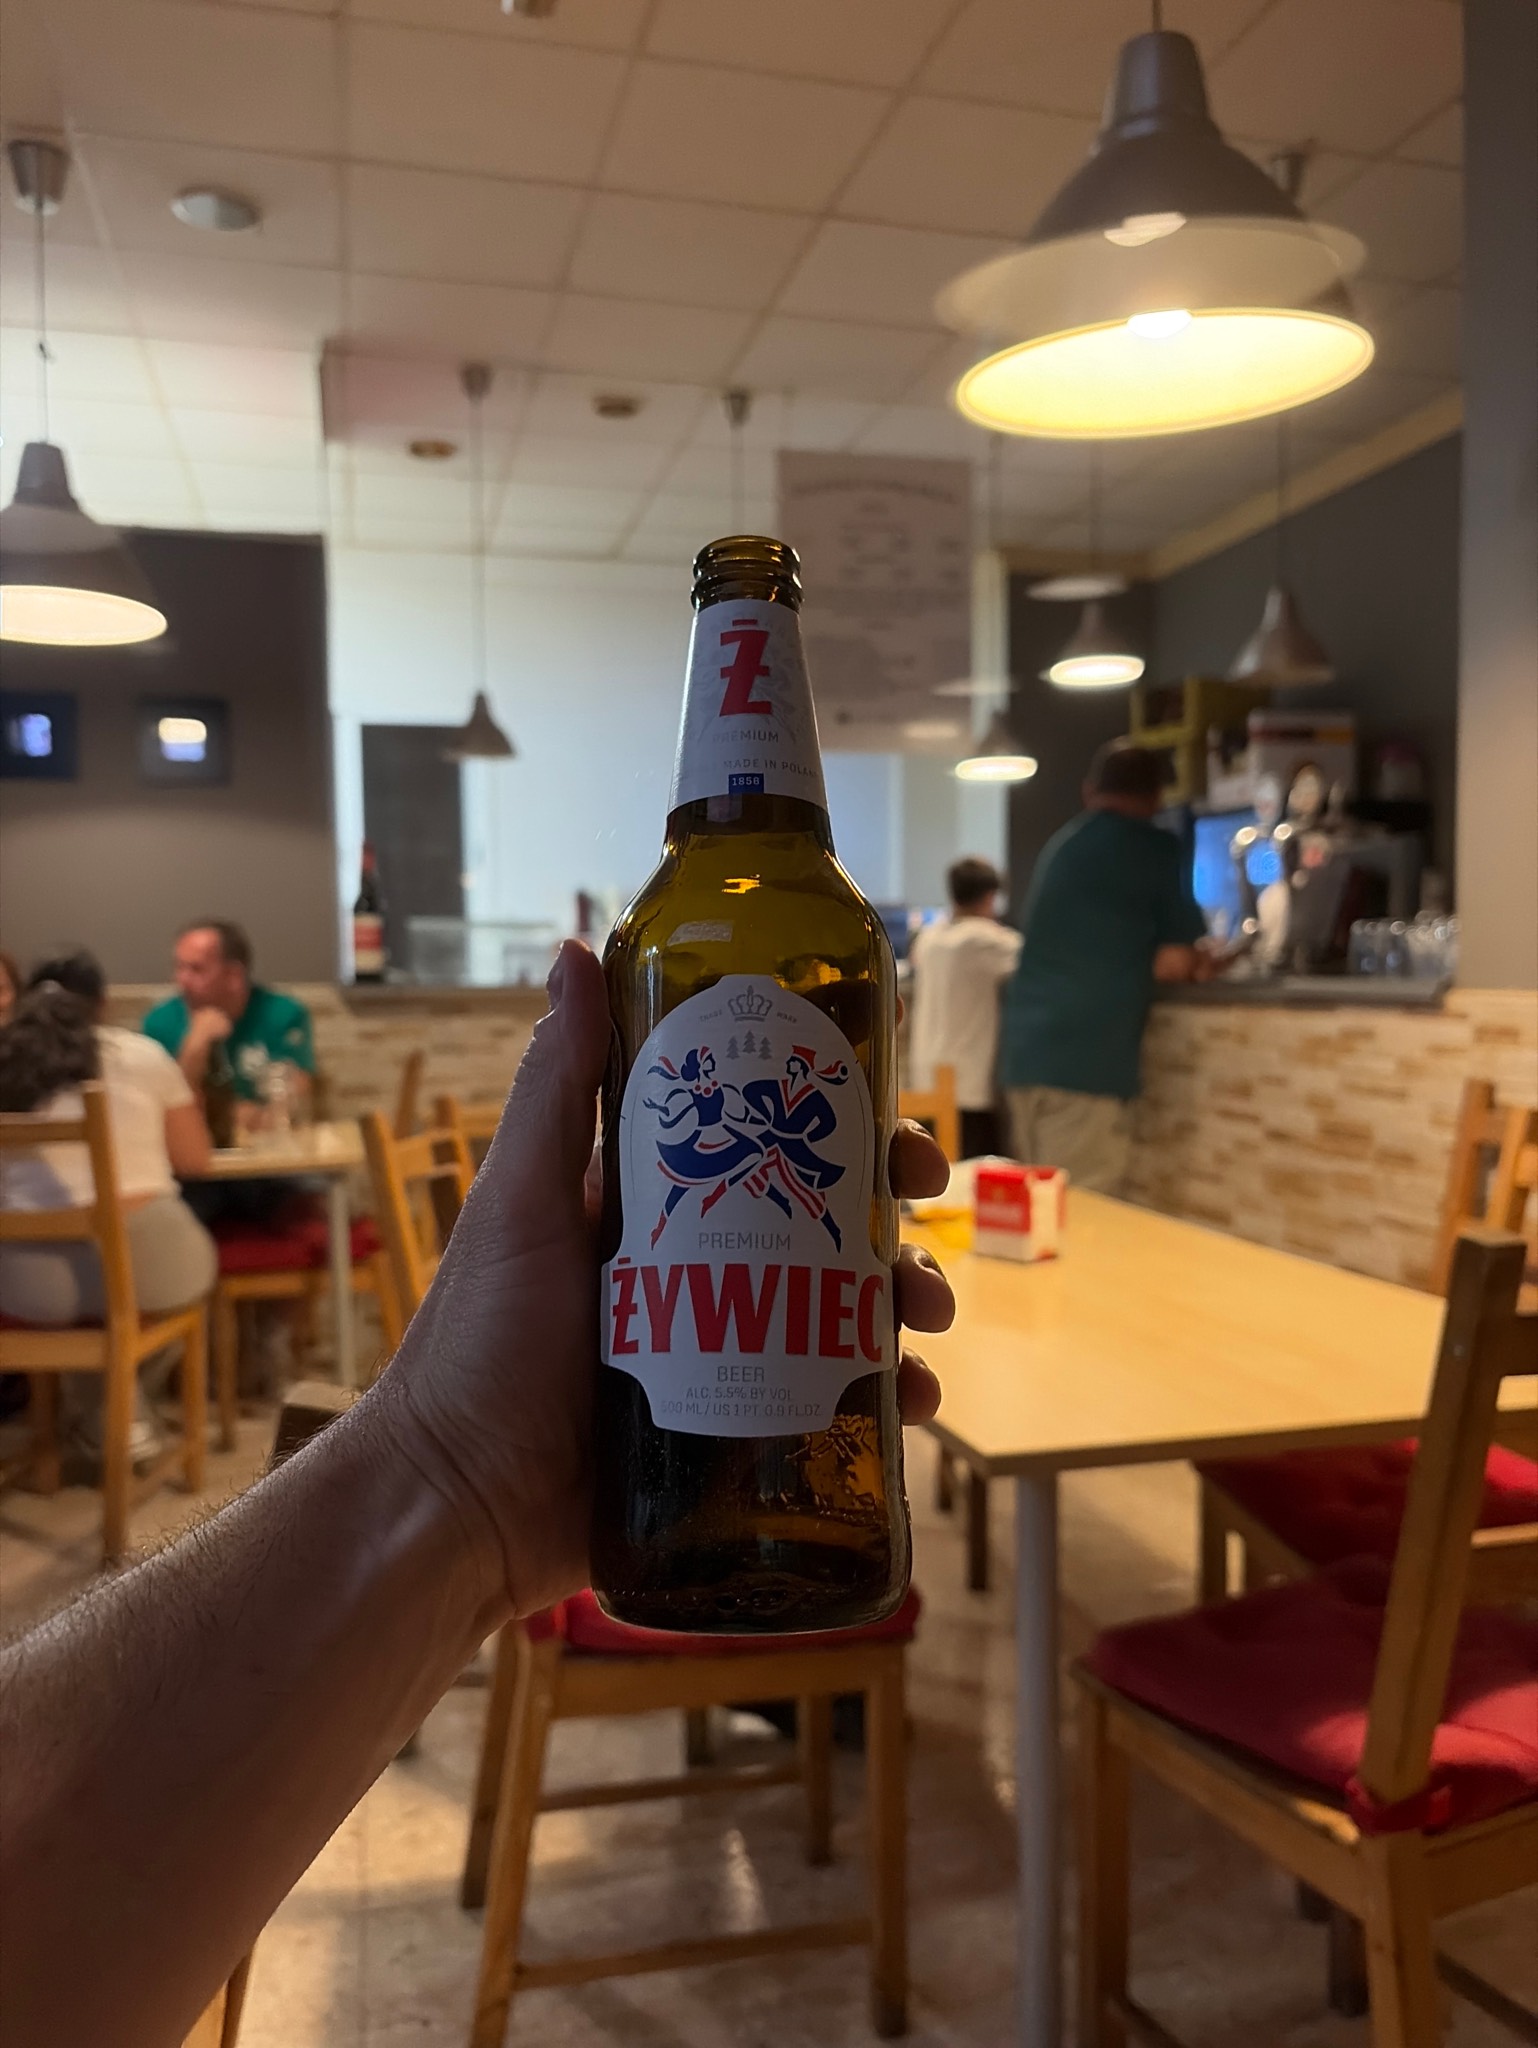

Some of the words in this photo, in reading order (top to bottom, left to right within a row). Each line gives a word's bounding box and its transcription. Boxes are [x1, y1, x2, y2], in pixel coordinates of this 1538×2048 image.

[712, 729, 779, 743] PREMIUM
[724, 758, 759, 769] MADE
[765, 759, 777, 769] IN
[699, 1232, 791, 1250] PREMIUM
[612, 1257, 884, 1363] ŻYWIEC
[717, 1366, 765, 1382] BEER
[686, 1387, 711, 1399] ALC.
[715, 1387, 747, 1399] 5.5%
[750, 1387, 766, 1400] BY
[661, 1401, 682, 1414] 500
[713, 1403, 730, 1416] US
[734, 1403, 739, 1416] 1
[764, 1404, 784, 1417] 0.9
